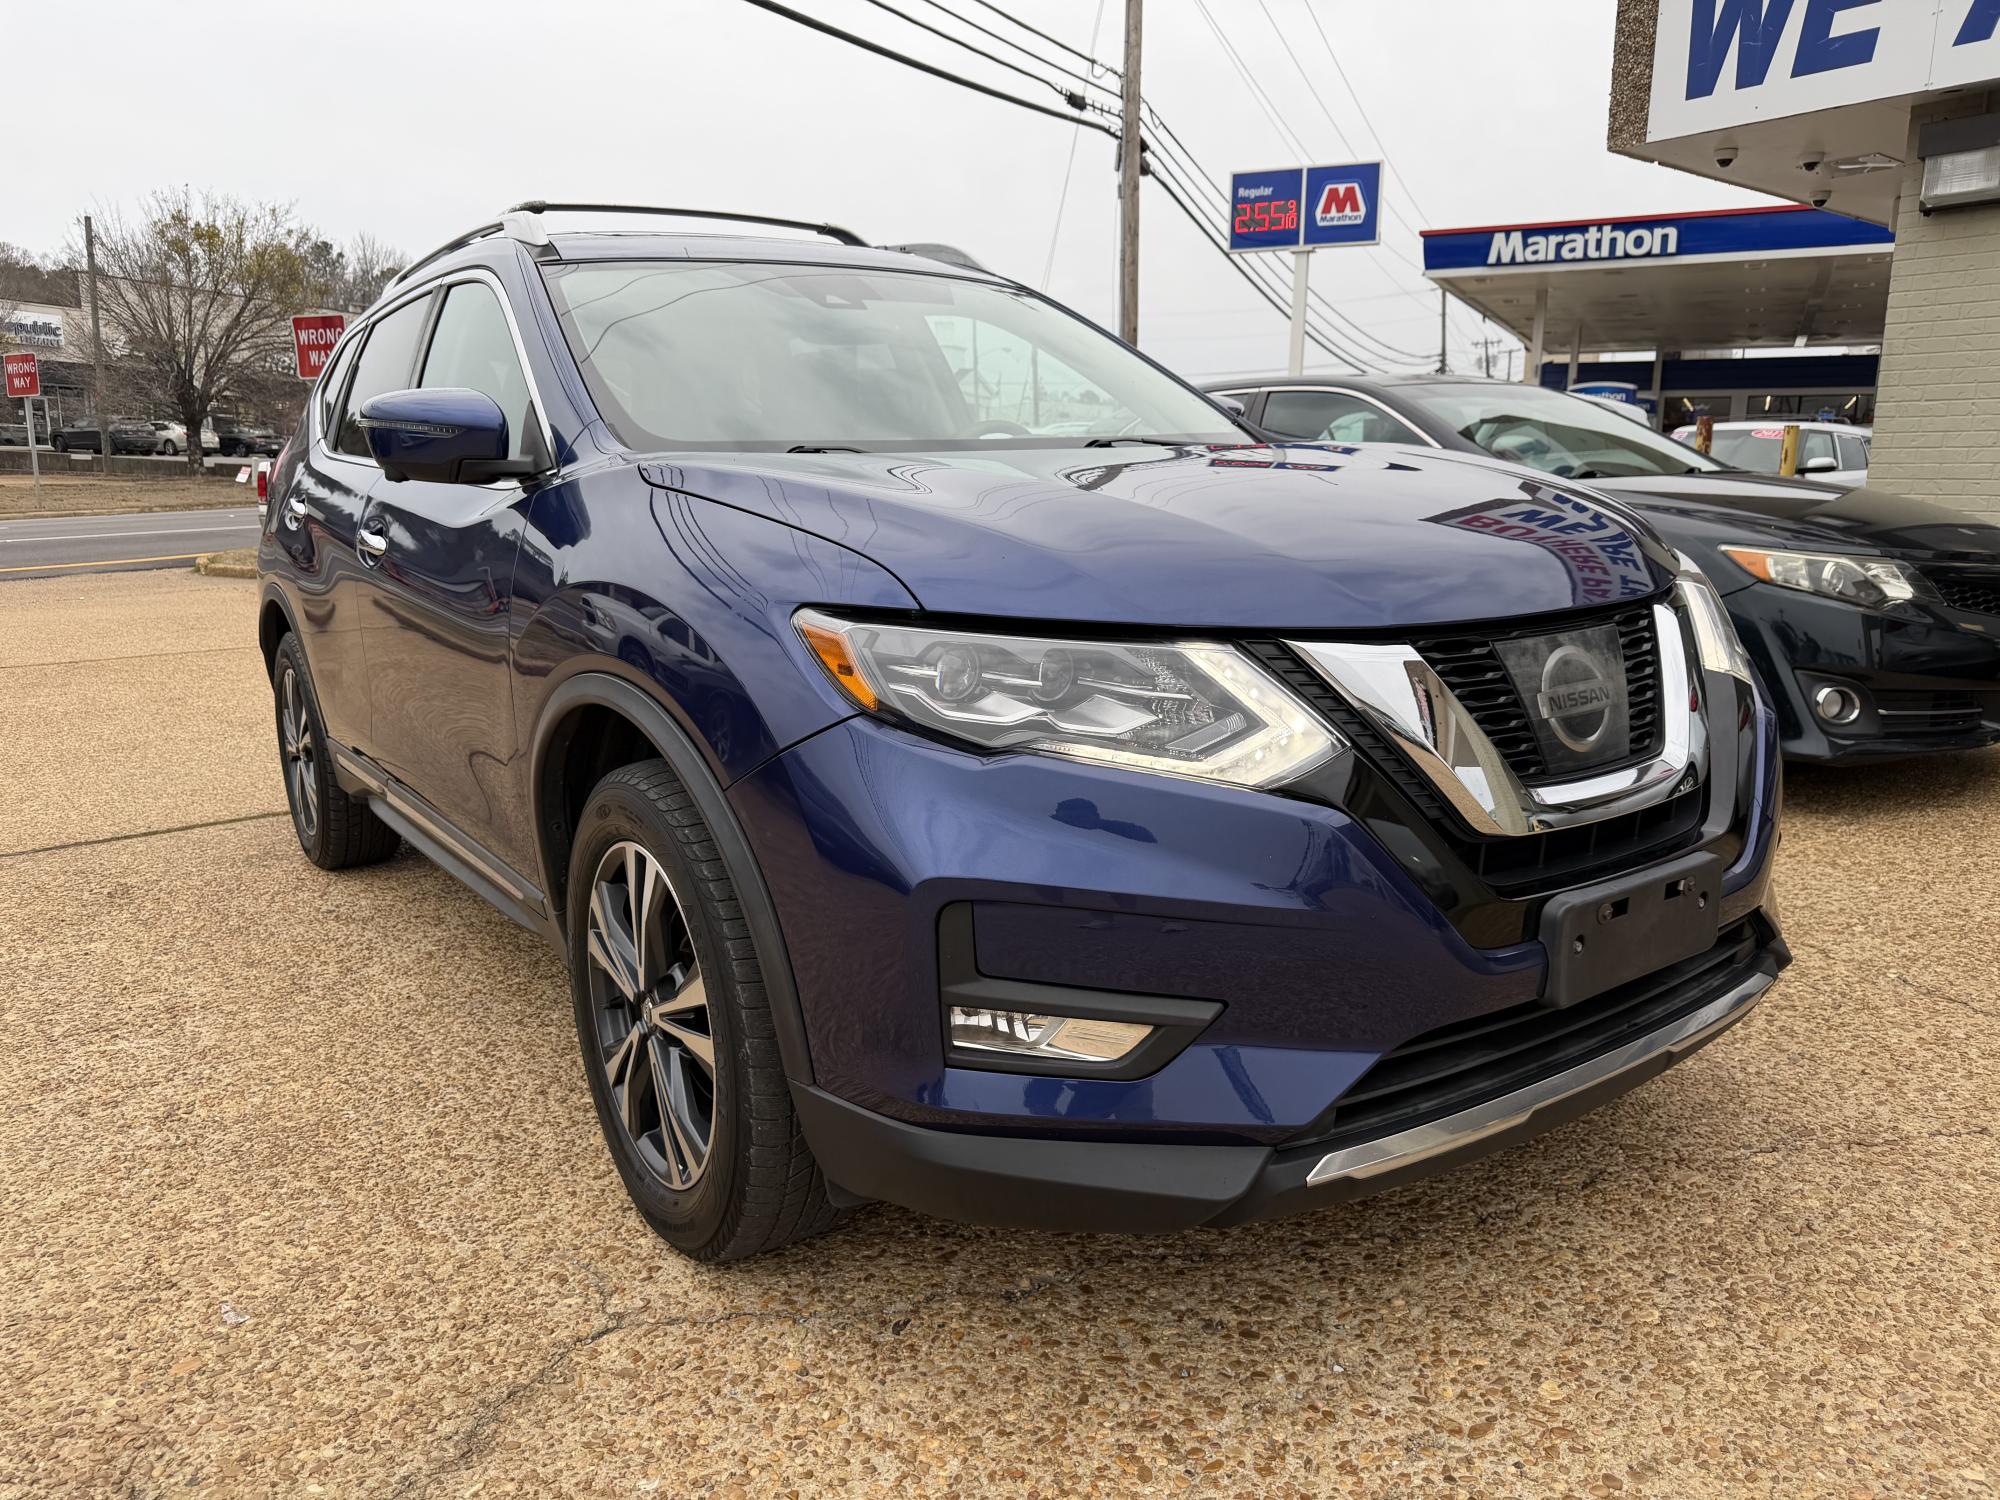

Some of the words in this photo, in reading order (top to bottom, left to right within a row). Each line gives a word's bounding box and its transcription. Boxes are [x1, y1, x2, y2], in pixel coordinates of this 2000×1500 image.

[1685, 0, 1881, 101] WE
[1238, 186, 1274, 198] Regular
[1319, 213, 1362, 224] Marathon
[1487, 225, 1678, 264] Marathon
[297, 327, 343, 345] WRONG
[309, 350, 331, 367] WA
[6, 361, 35, 375] WRONG
[13, 377, 31, 389] WAY
[1548, 686, 1610, 712] NISSAN
